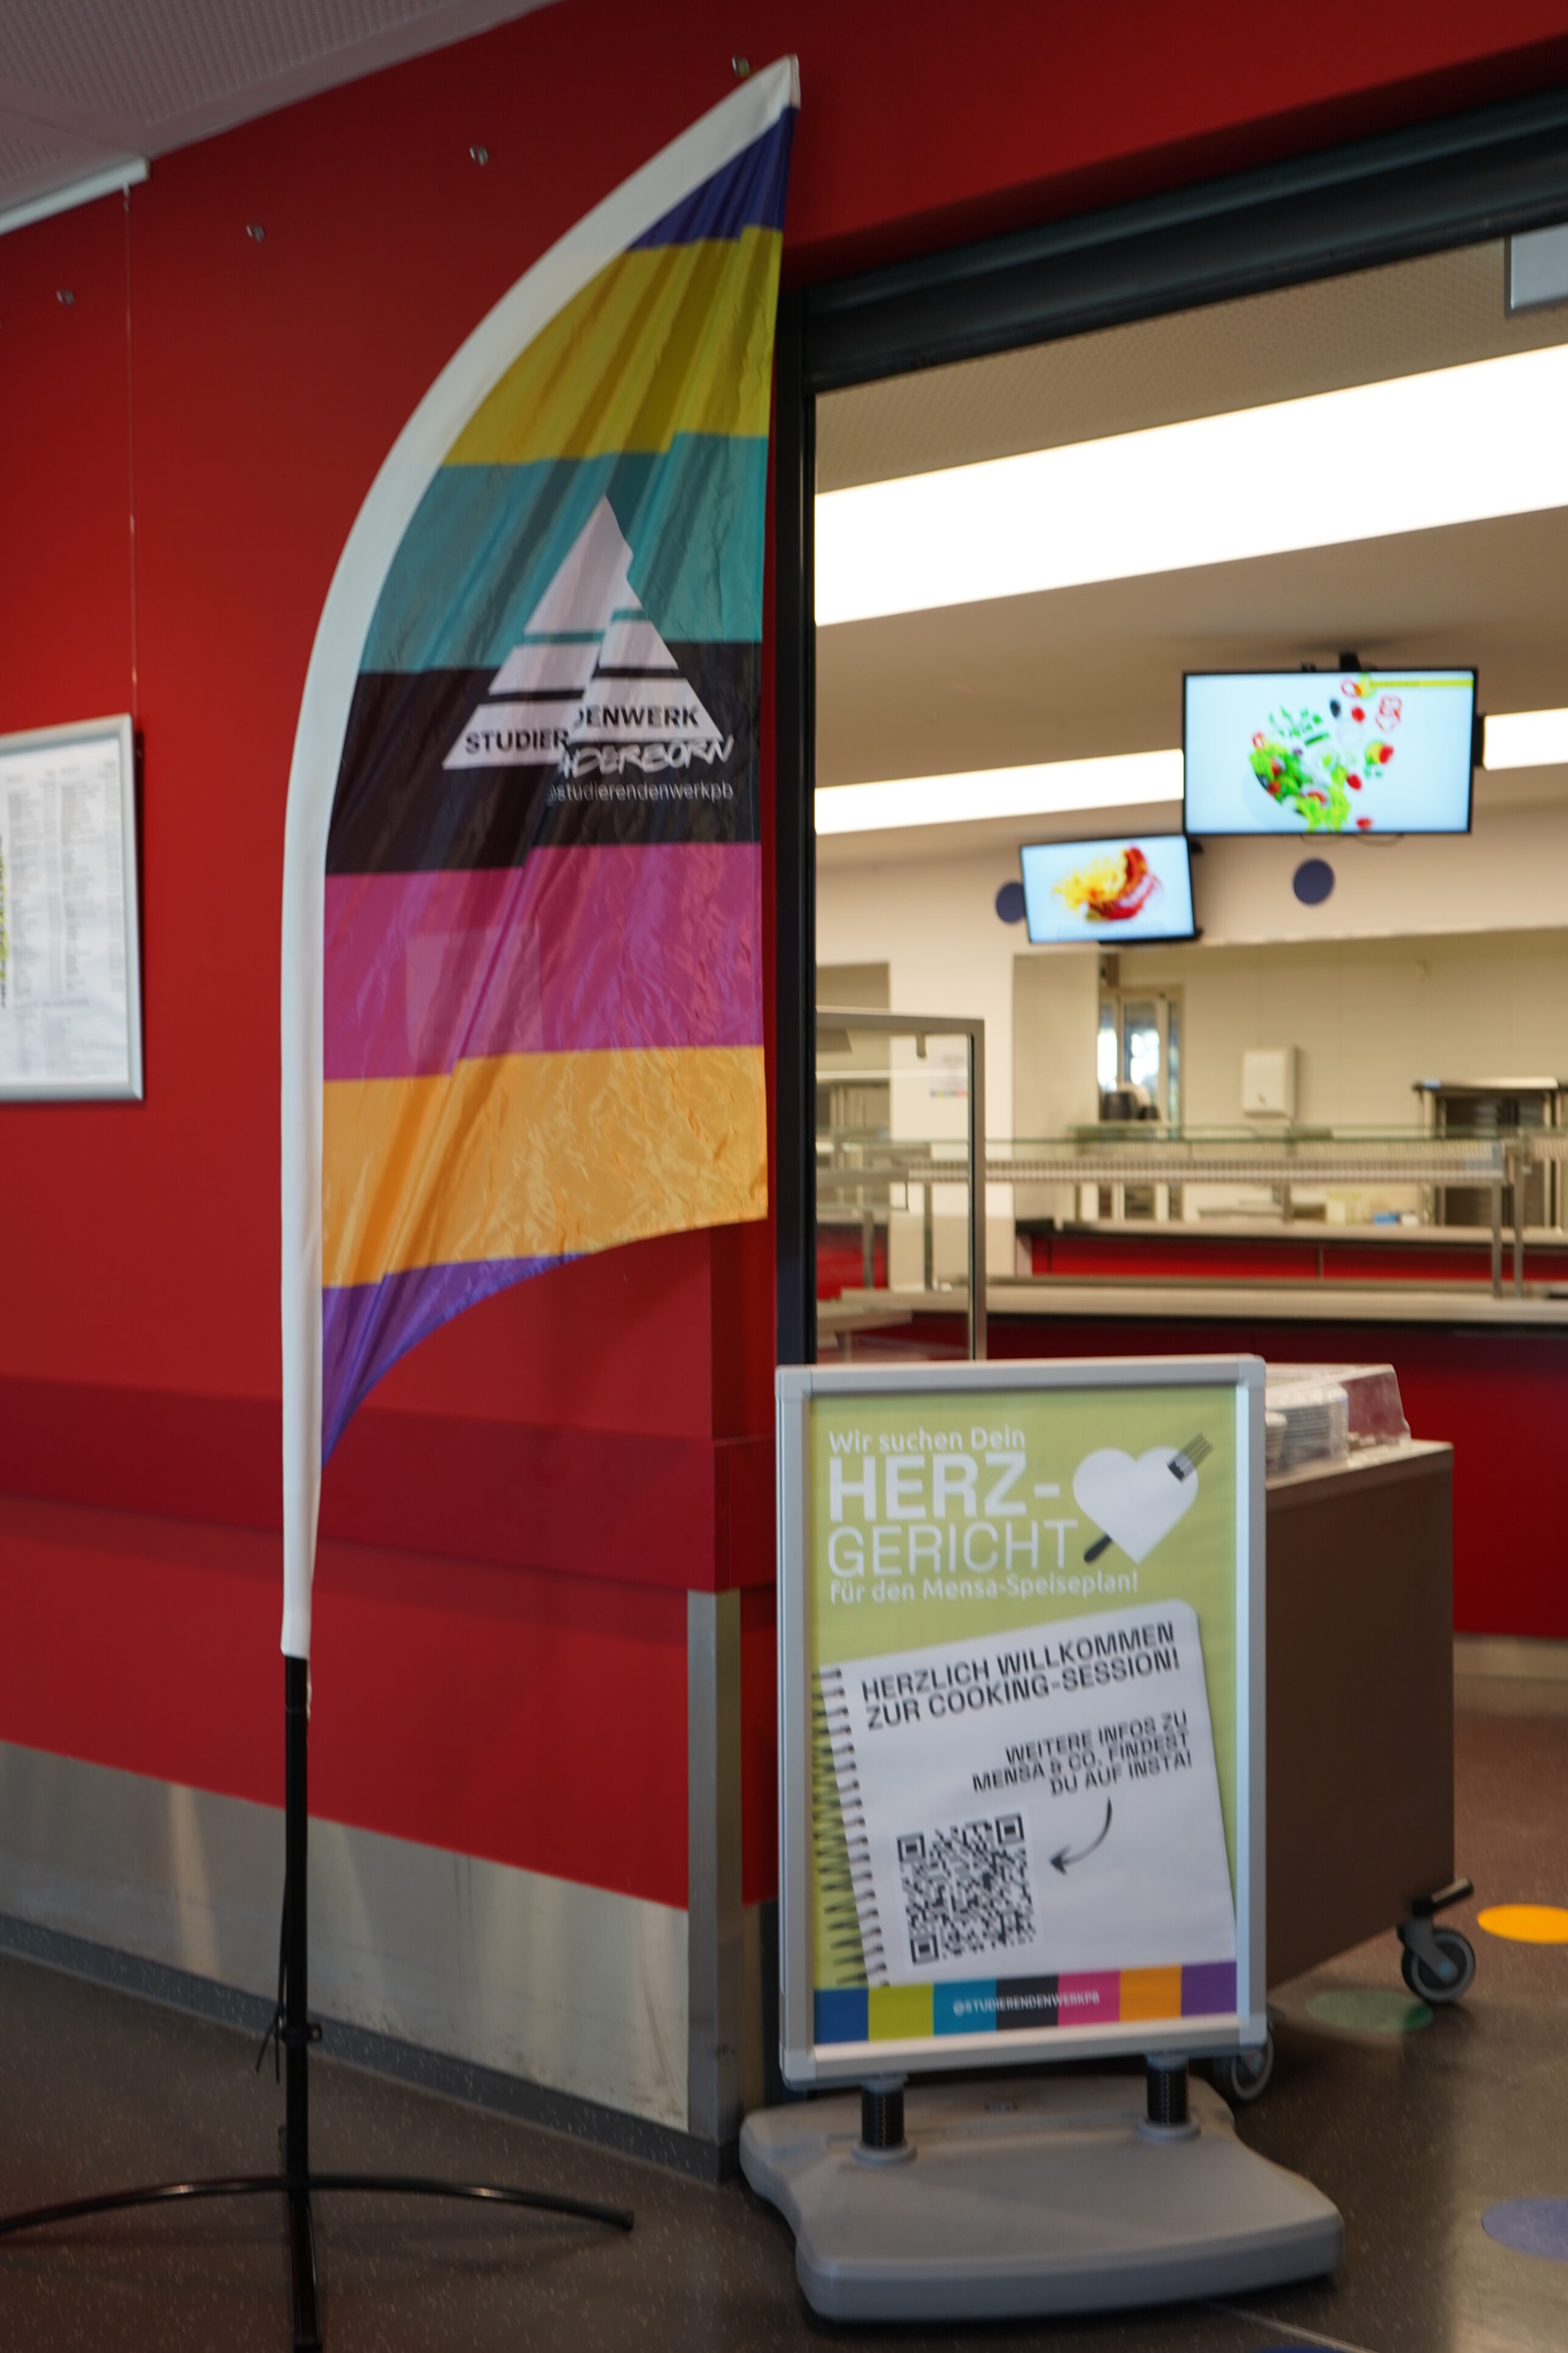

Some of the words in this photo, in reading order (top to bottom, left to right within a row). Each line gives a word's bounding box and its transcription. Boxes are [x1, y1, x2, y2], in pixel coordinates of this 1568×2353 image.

[828, 1429, 872, 1454] Wir
[879, 1426, 963, 1453] suchen
[971, 1424, 1026, 1451] Dein
[829, 1450, 1060, 1522] HERZ-
[828, 1519, 1079, 1578] GERICHT
[831, 1578, 866, 1604] für
[872, 1578, 915, 1603] den
[923, 1570, 1138, 1601] Mensa-Speiseplan!
[861, 1657, 990, 1703] HERZLICH
[996, 1620, 1175, 1678] WILLKOMMEN
[865, 1698, 921, 1731] ZUR
[928, 1646, 1180, 1718] COOKING-SESSION!
[972, 1762, 1045, 1793] MENSA
[1068, 1750, 1102, 1772] CO.
[1108, 1730, 1188, 1762] FINDEST
[1005, 1729, 1093, 1765] WEITERE
[1098, 1715, 1157, 1746] INFOS
[1161, 1709, 1187, 1731] ZU
[1051, 1775, 1078, 1797] DU
[1085, 1764, 1123, 1790] AUF
[1127, 1750, 1192, 1781] INSTA!
